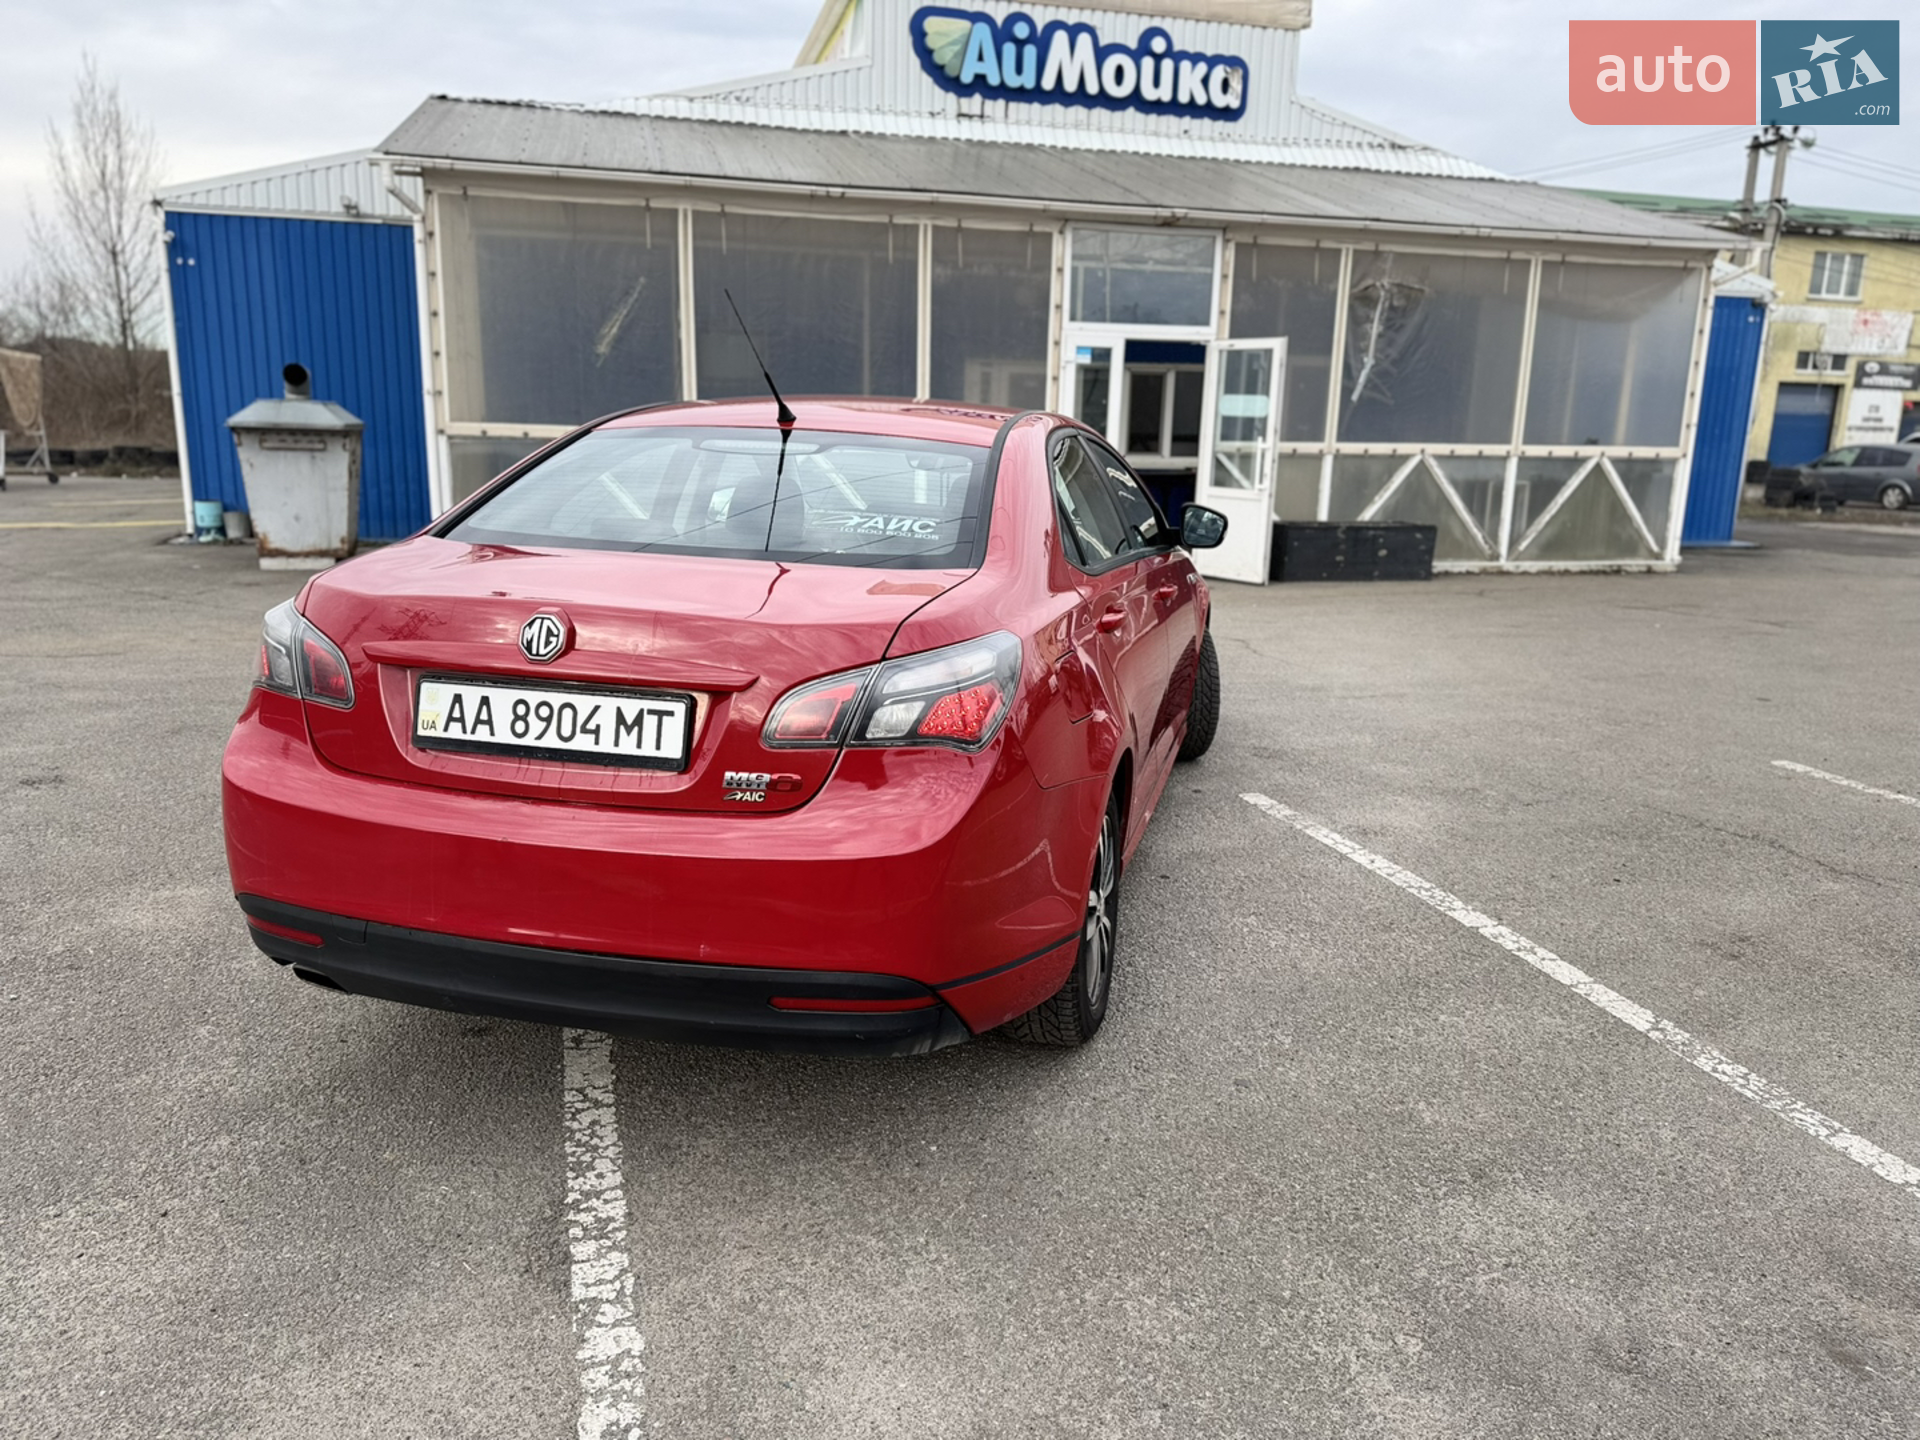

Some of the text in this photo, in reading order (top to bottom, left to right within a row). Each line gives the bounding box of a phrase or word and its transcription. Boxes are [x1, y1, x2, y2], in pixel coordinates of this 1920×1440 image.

[959, 21, 1243, 109] АйМойка
[522, 618, 560, 655] MG
[421, 719, 437, 731] UA
[443, 693, 675, 751] AA 8904 MT
